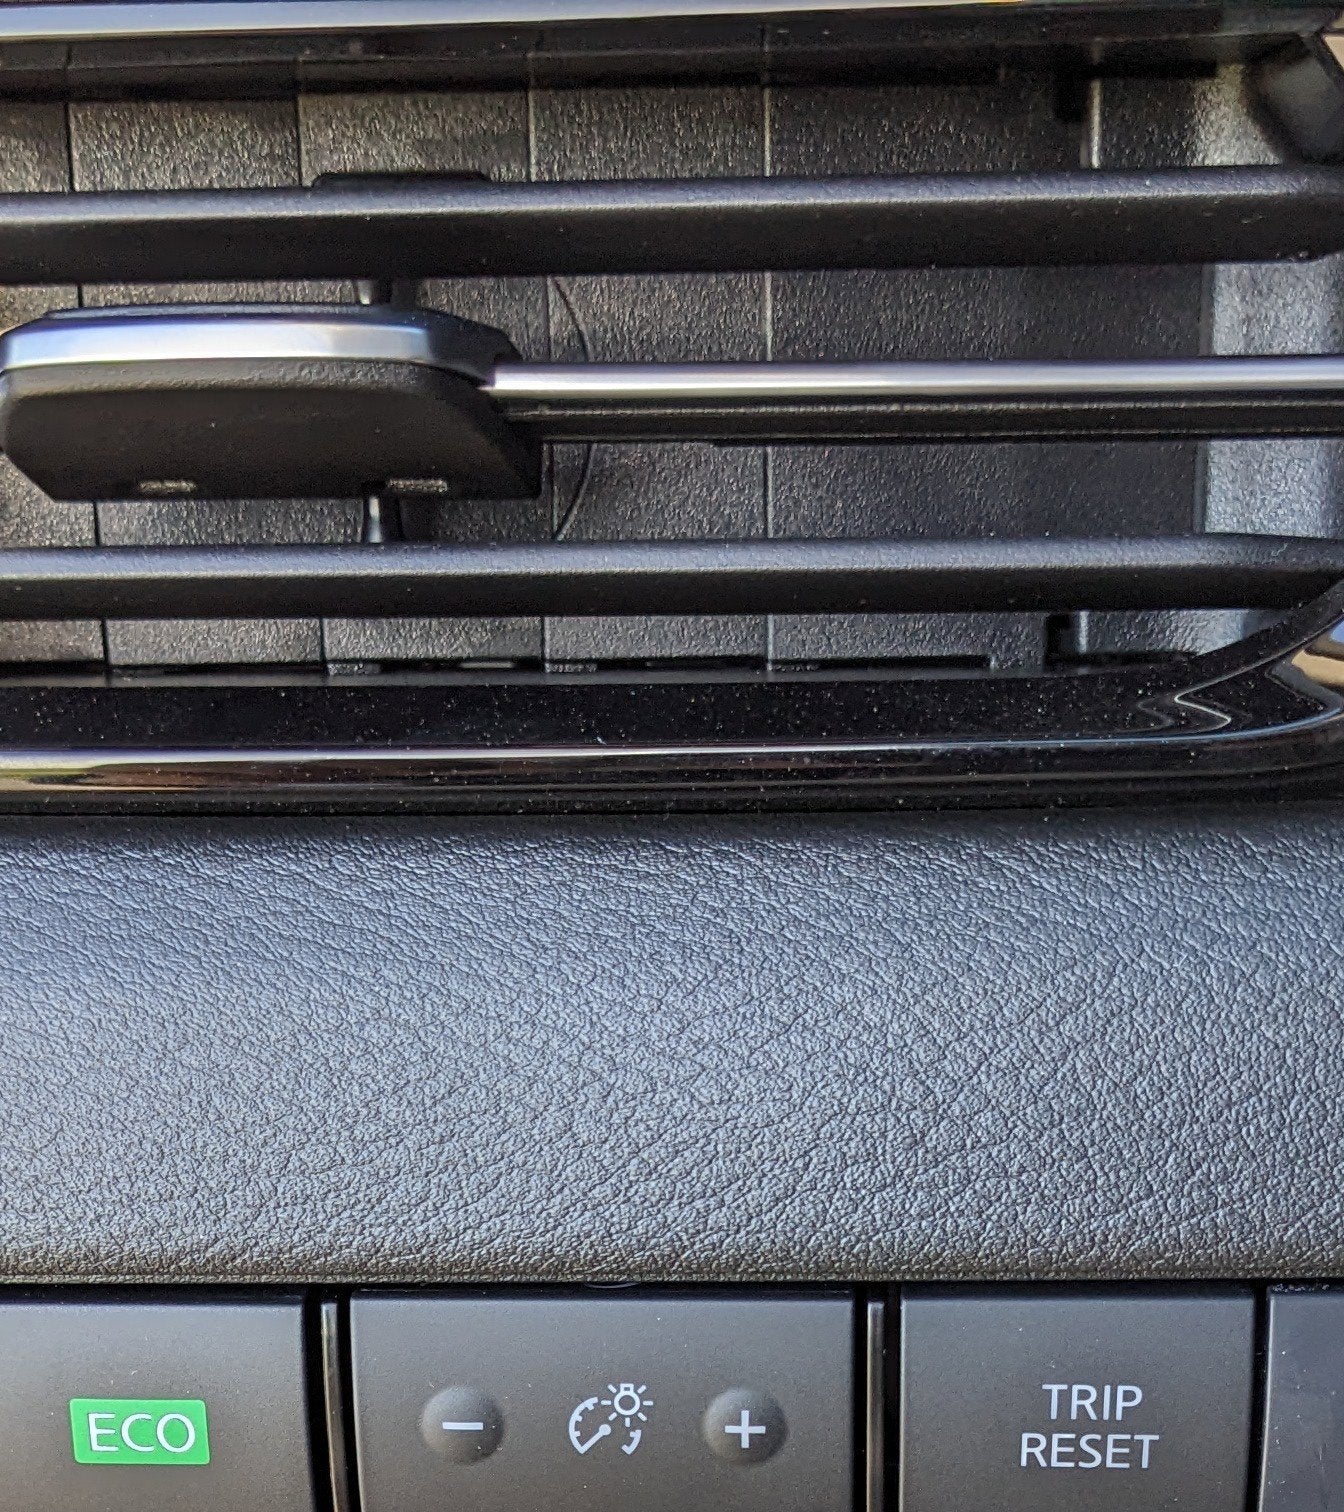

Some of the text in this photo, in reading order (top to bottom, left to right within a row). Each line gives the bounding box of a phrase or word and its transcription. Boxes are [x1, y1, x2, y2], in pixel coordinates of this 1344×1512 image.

[1042, 1384, 1143, 1421] TRIP
[88, 1412, 196, 1453] ECO
[1020, 1432, 1160, 1469] RESET
